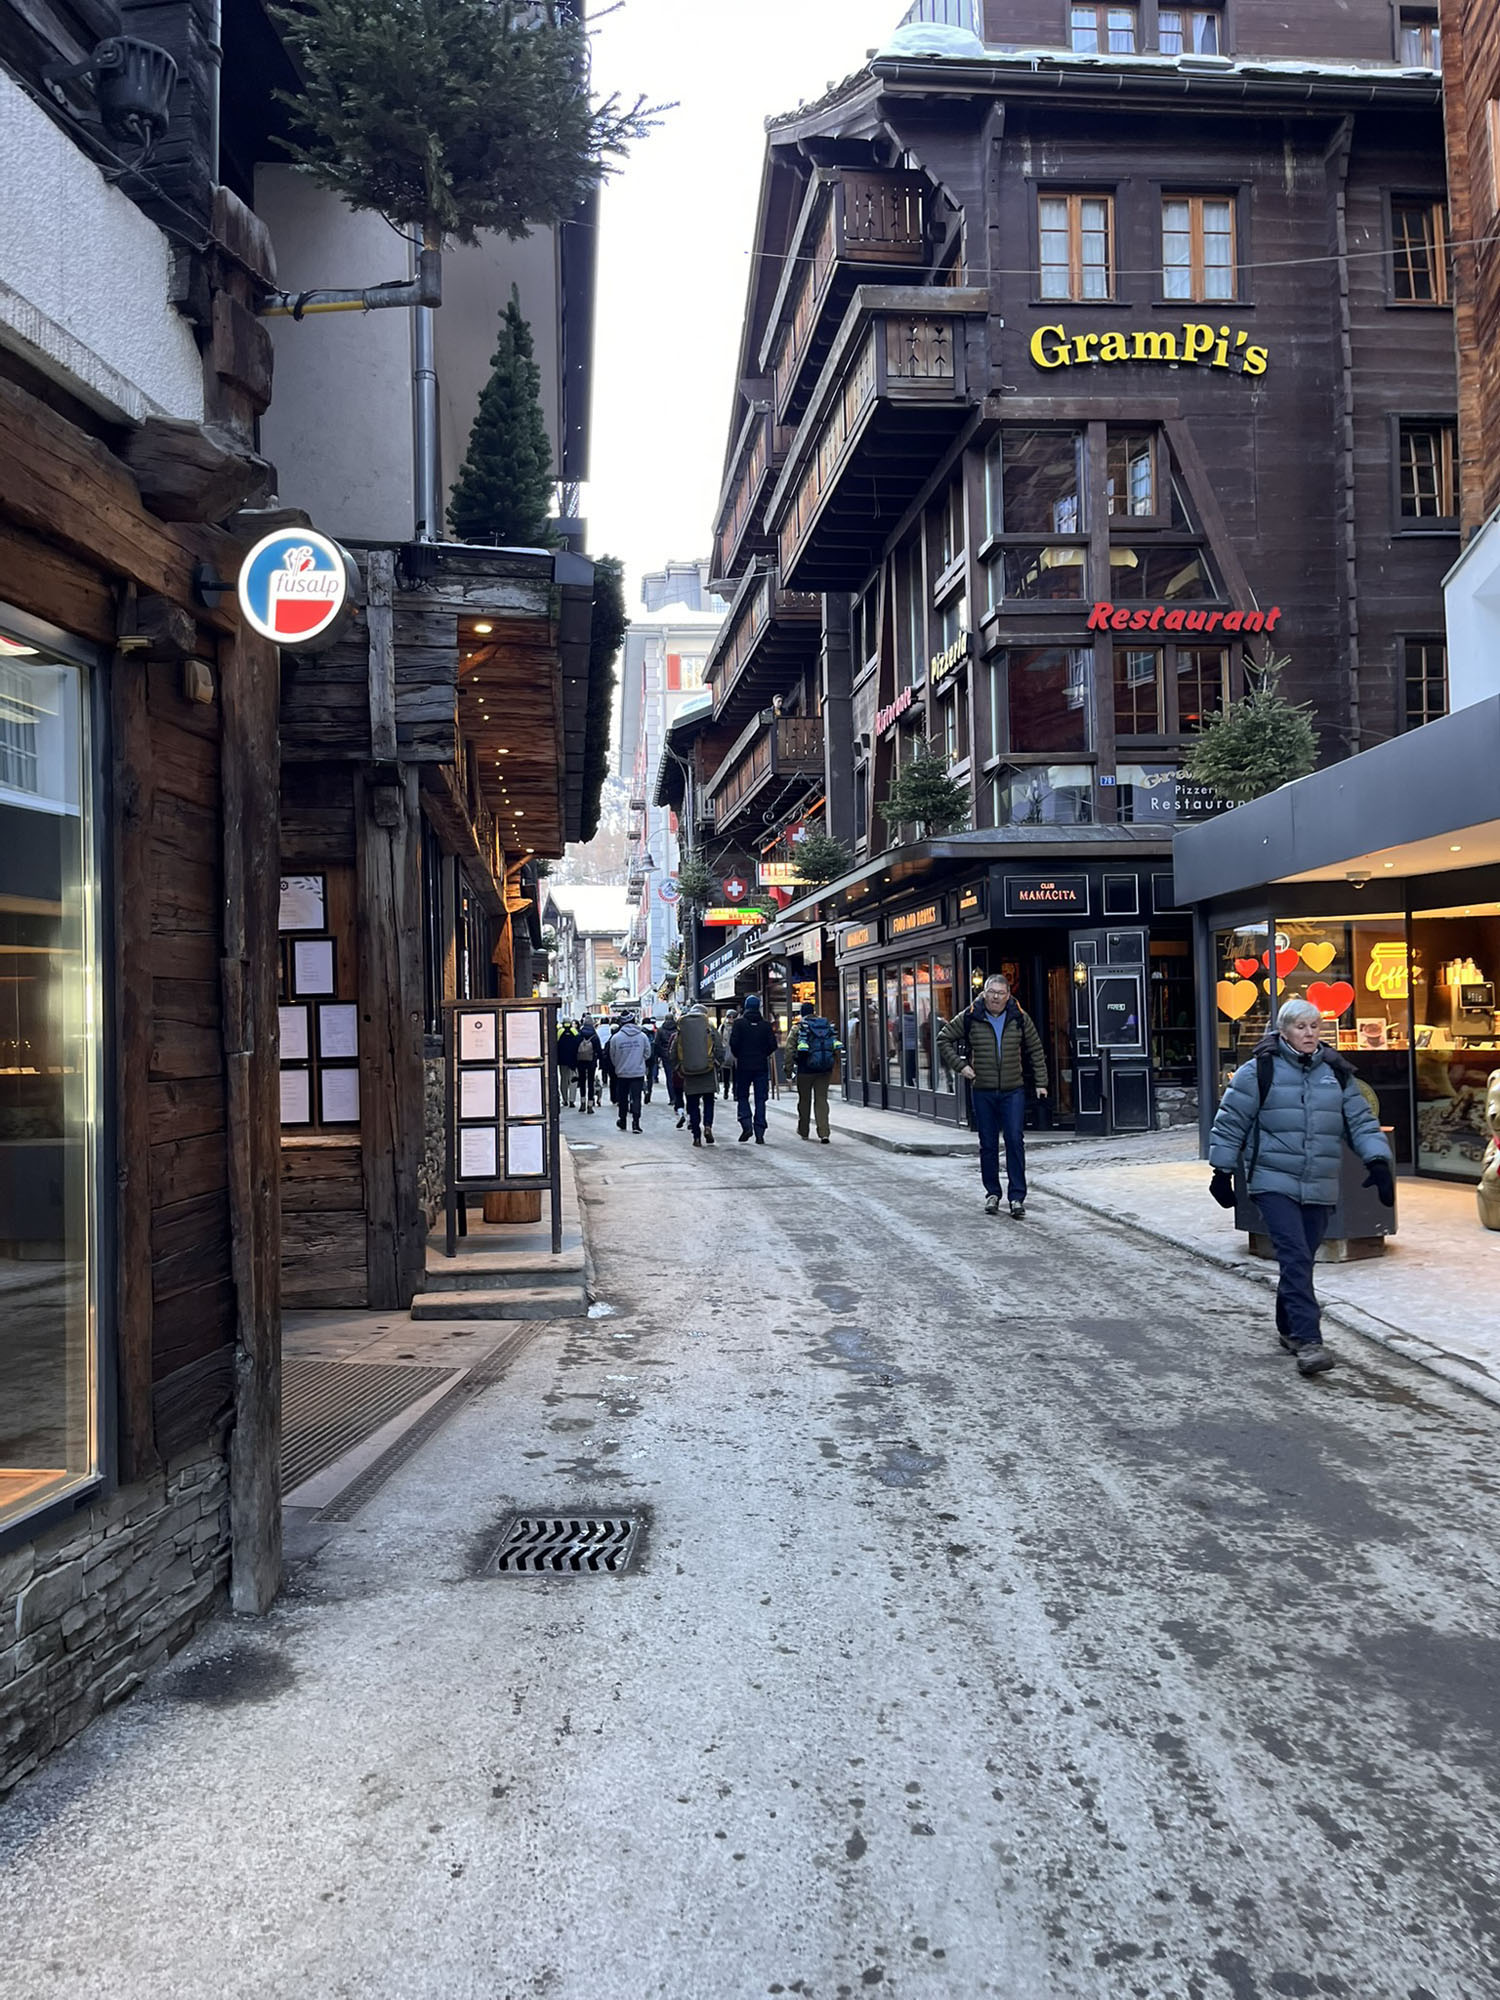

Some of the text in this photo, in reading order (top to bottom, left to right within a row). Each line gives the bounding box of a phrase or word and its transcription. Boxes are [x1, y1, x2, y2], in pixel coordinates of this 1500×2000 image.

[276, 572, 340, 598] fusalp
[1086, 601, 1281, 632] Restaurant
[931, 629, 968, 685] Pizzeria
[1175, 784, 1218, 795] Pizzeri
[1151, 797, 1249, 810] Restauran
[1040, 882, 1055, 890] CLUB
[1019, 890, 1077, 900] MAMACITA
[893, 916, 906, 933] FOOD
[906, 912, 916, 929] AND
